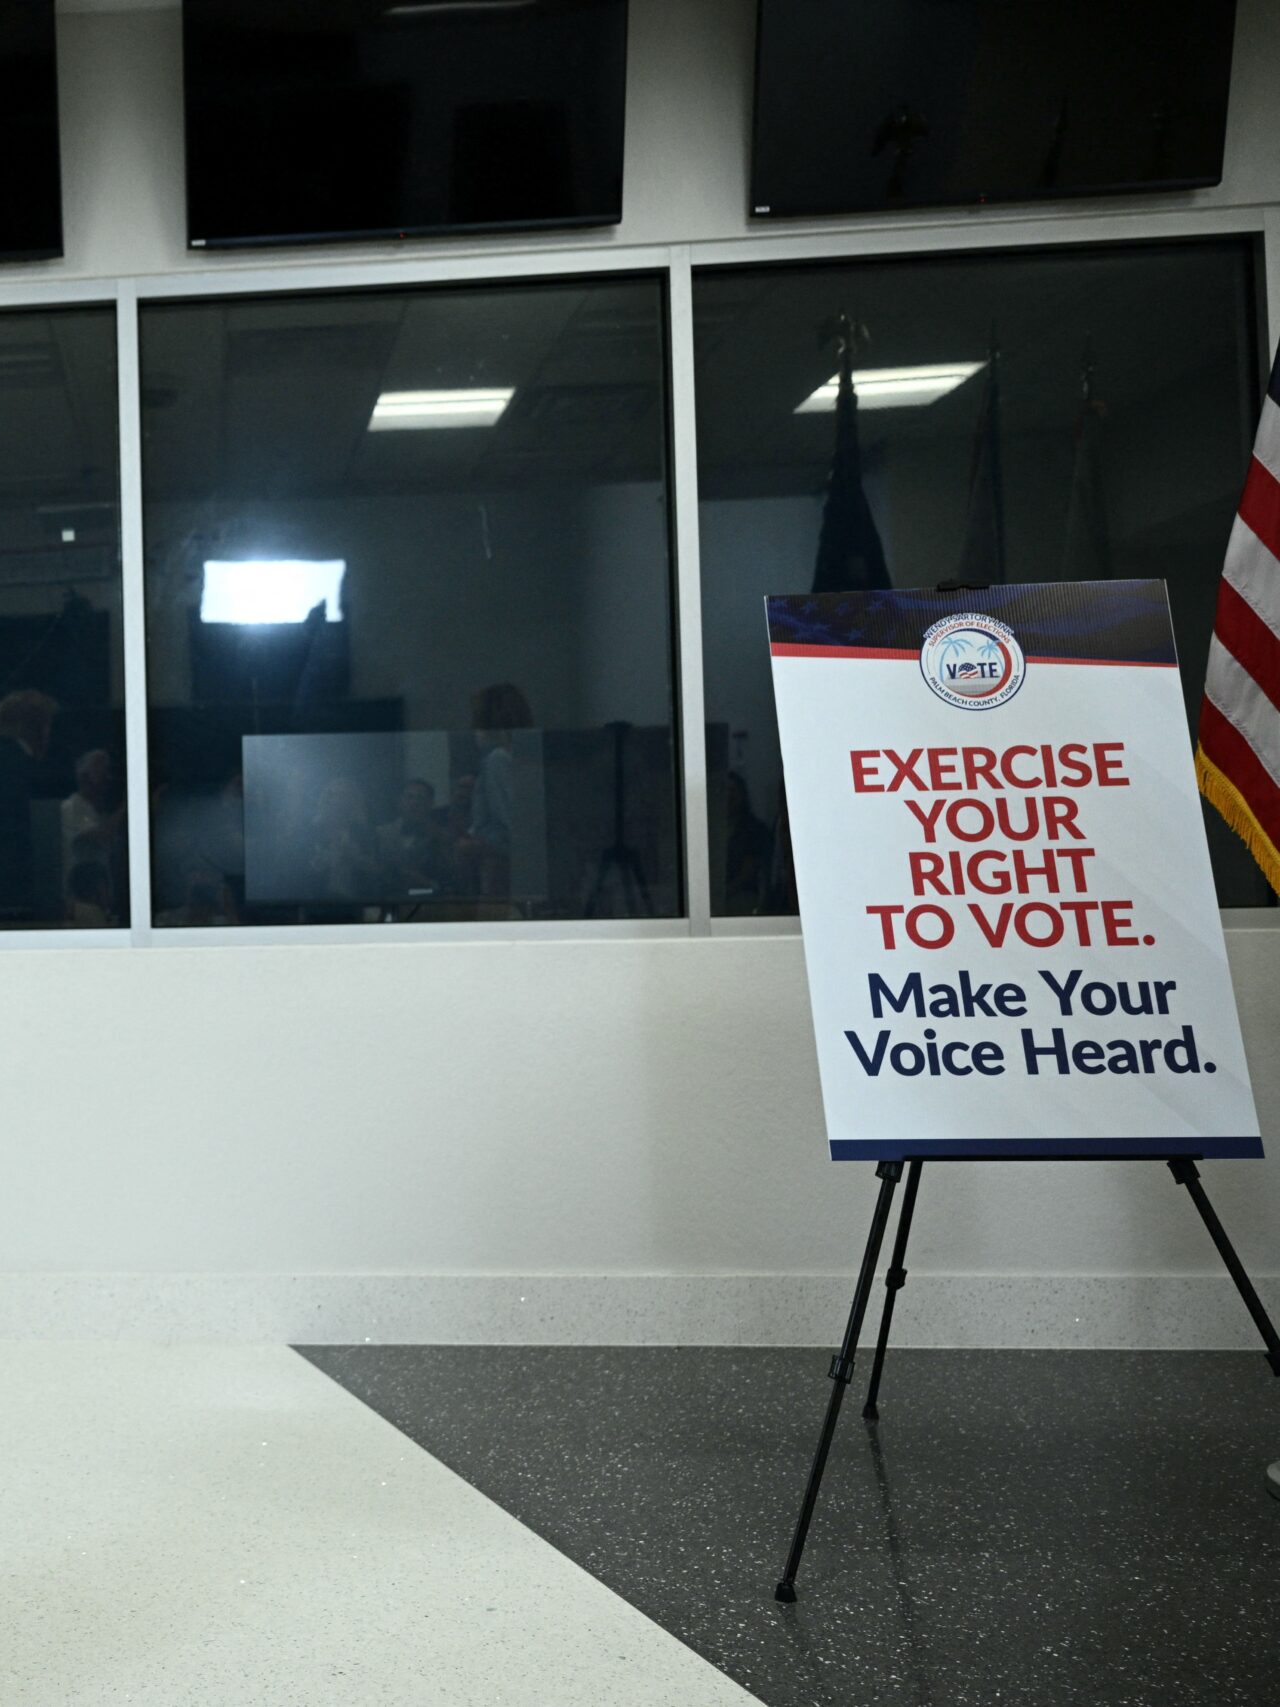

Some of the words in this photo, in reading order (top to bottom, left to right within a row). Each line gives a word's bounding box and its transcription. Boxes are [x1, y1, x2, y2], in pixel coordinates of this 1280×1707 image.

[925, 616, 950, 638] WENDY
[928, 622, 964, 647] SUPERVISOR
[976, 621, 1011, 644] ELECTIONS
[929, 677, 945, 695] PALM
[944, 691, 967, 706] BEACH
[968, 698, 1000, 707] COUNTY,
[1000, 674, 1020, 698] FLORIDA
[946, 662, 1000, 680] VOTE
[851, 743, 1129, 792] EXERCISE
[904, 797, 1086, 842] YOUR
[909, 848, 1095, 895] RIGHT
[866, 903, 954, 950] TO
[967, 900, 1155, 948] VOTE.
[868, 970, 1027, 1018] Make
[1038, 970, 1176, 1016] Your
[844, 1029, 1005, 1076] Voice
[1021, 1025, 1216, 1075] Heard.
